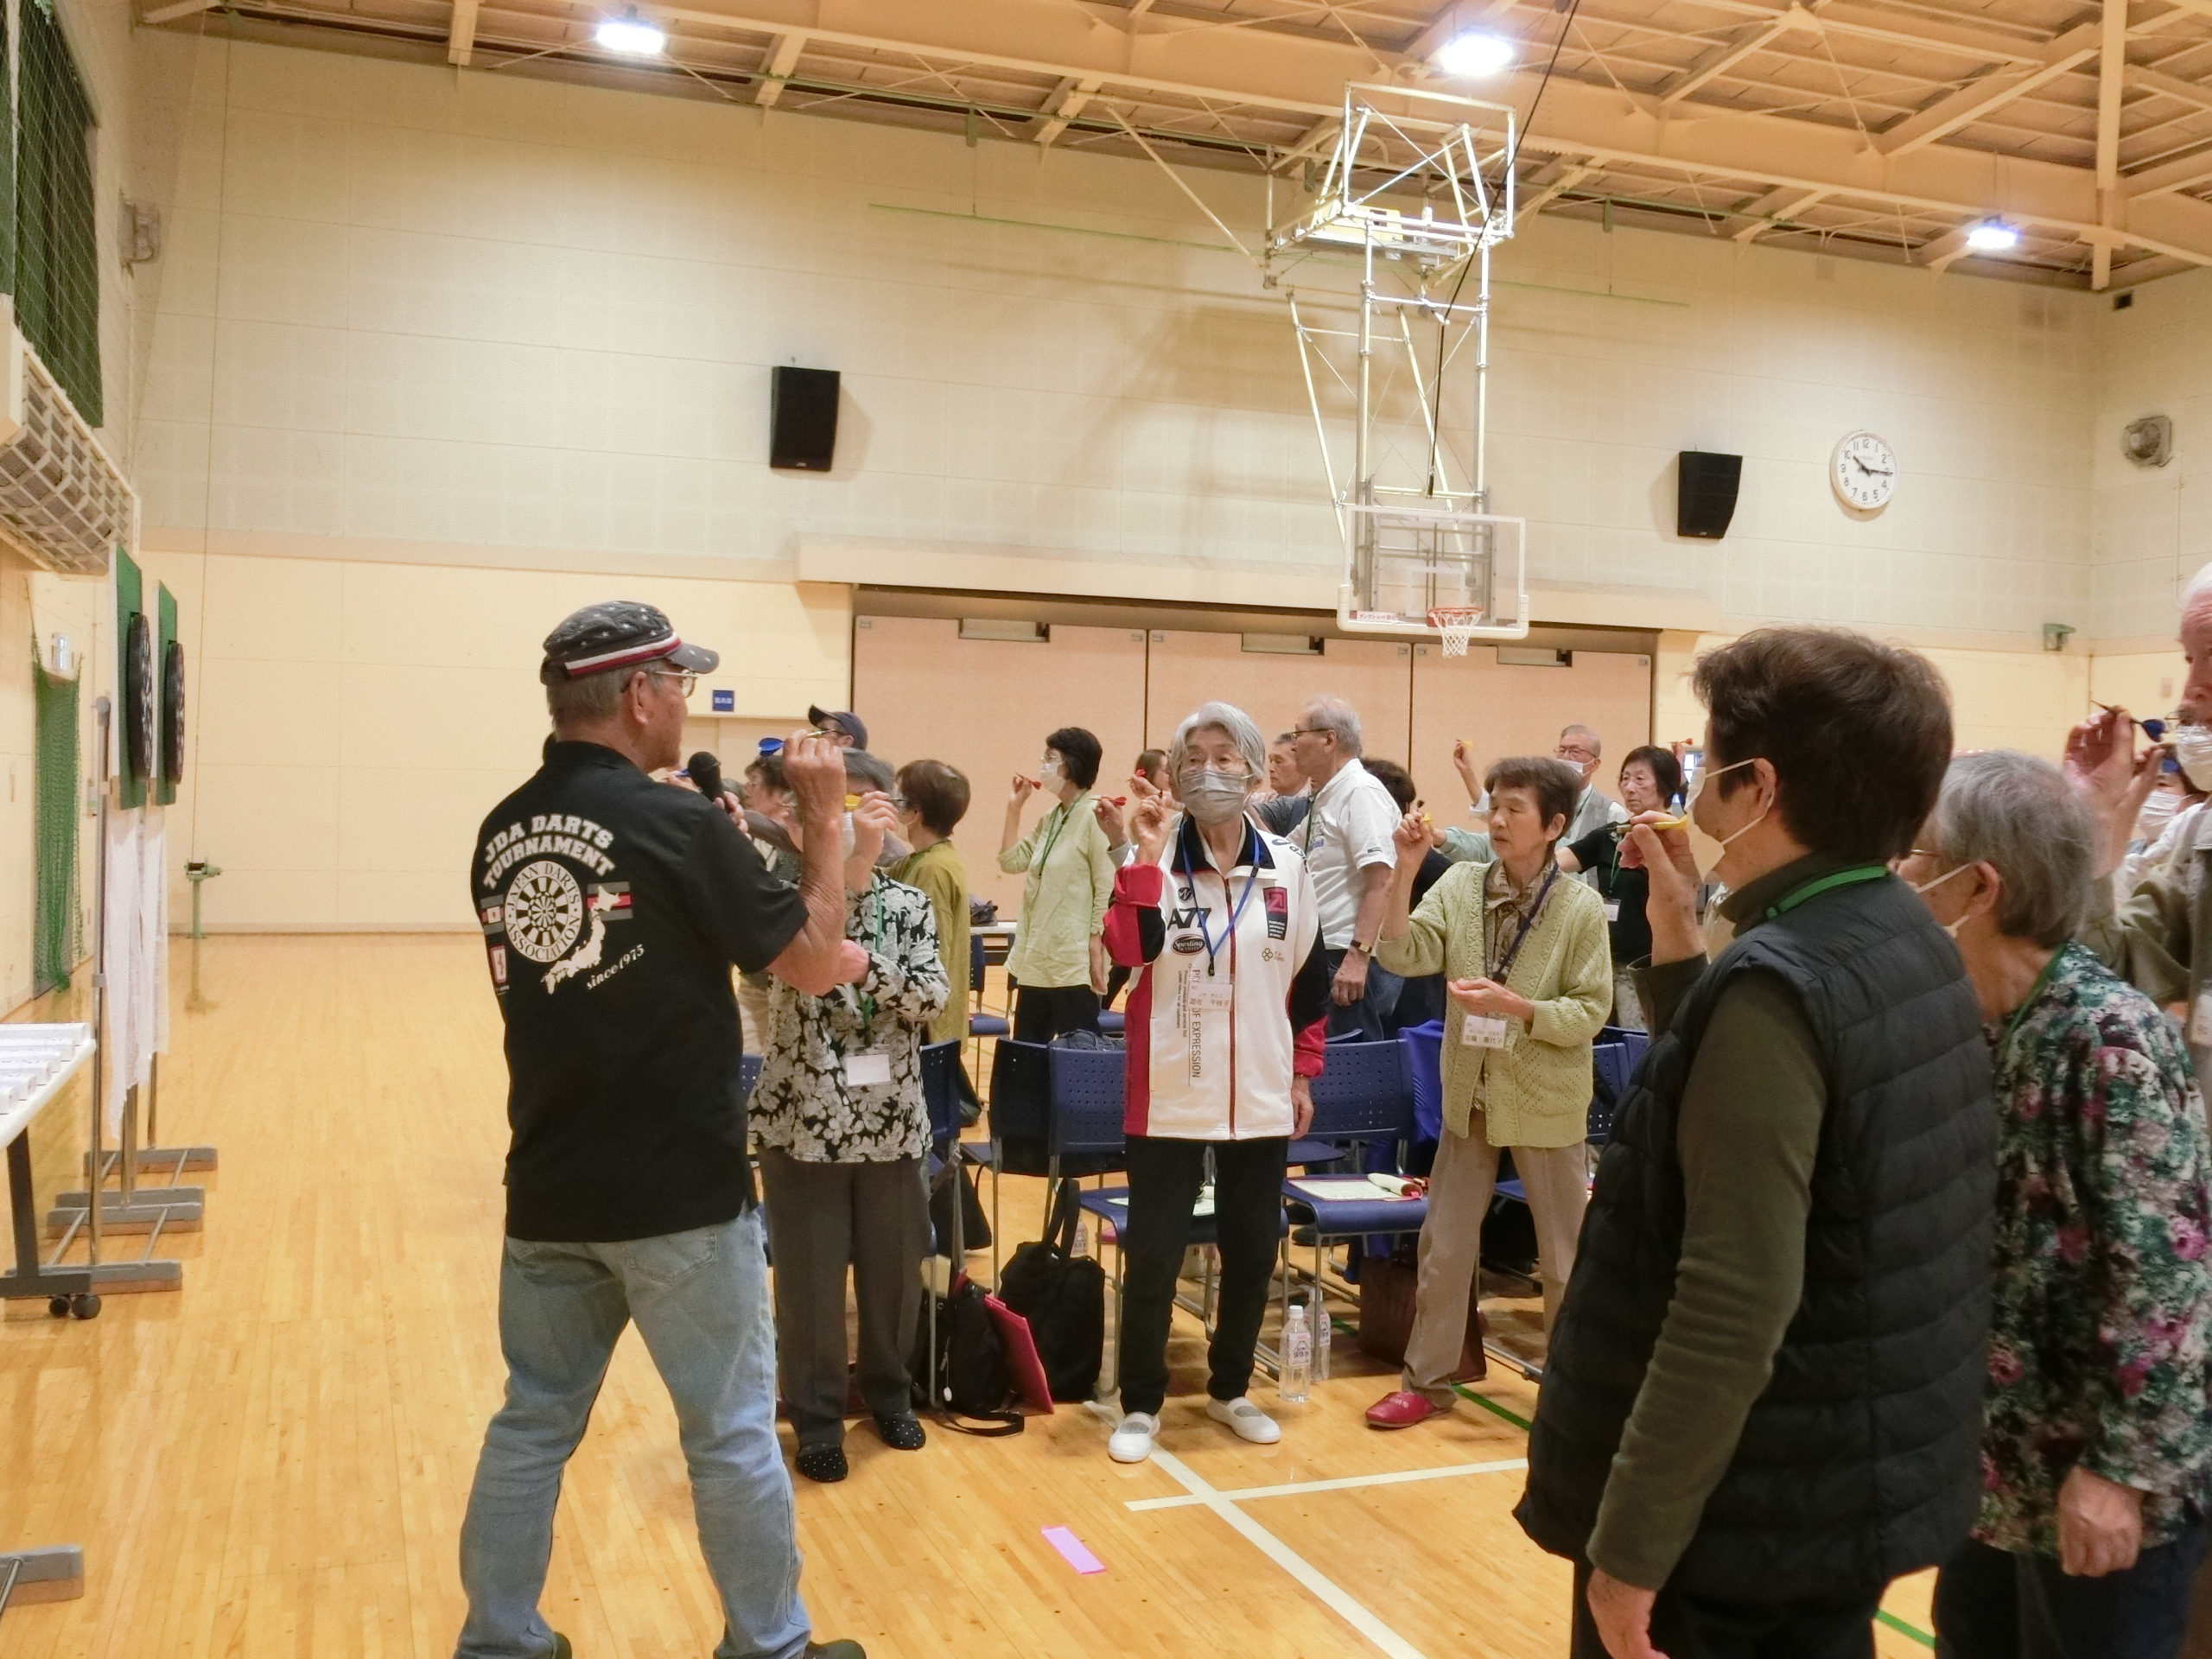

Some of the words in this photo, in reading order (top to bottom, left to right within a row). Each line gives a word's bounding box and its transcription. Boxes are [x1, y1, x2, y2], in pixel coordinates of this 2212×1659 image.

[1853, 441, 1859, 451] 11
[1863, 438, 1870, 448] 12
[1844, 449, 1851, 460] 10
[1882, 454, 1887, 464] 2
[1840, 463, 1846, 474] 9
[1844, 477, 1849, 486] 8
[1881, 480, 1887, 488] 4
[1853, 487, 1858, 498] 7
[1862, 492, 1867, 501] 6
[1873, 489, 1878, 499] 5
[485, 822, 525, 863] JDA
[531, 813, 615, 849] DARTS
[483, 835, 616, 889] TOURNAMENT
[506, 864, 537, 912] JAPAN
[544, 862, 580, 905] DARTS
[1167, 907, 1211, 931] A77
[506, 915, 582, 961] ASSOCIATION
[1175, 938, 1204, 950] Sporting
[1192, 1021, 1202, 1077] EXPRESSION
